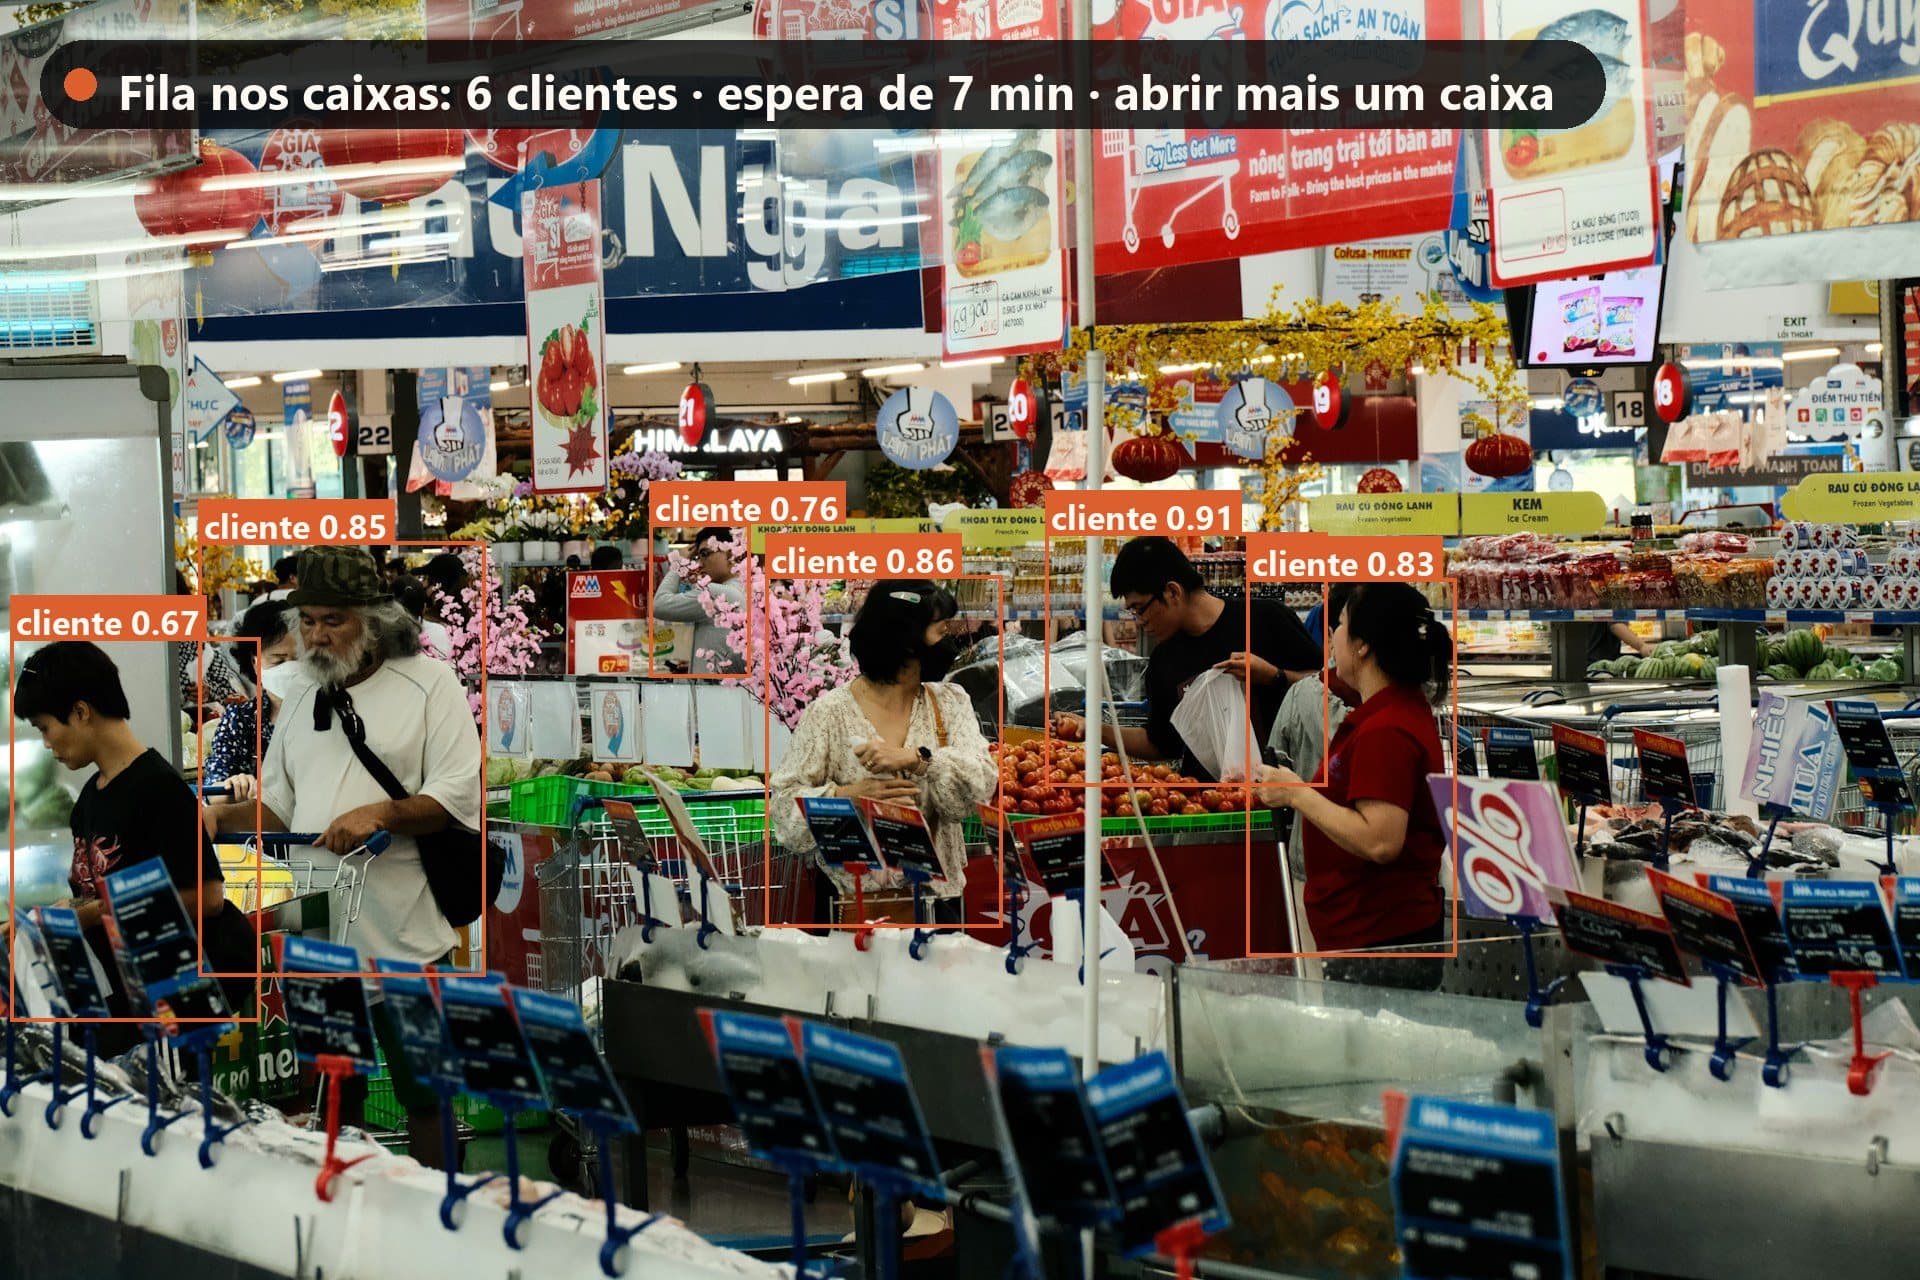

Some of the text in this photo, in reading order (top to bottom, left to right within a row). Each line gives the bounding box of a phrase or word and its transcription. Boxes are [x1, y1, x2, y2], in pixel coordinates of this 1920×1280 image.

[1166, 142, 1188, 164] Less
[1190, 138, 1208, 158] Get
[1249, 149, 1285, 179] nông
[1291, 144, 1334, 172] trang
[1336, 131, 1365, 168] trại
[1368, 129, 1392, 159] tới
[1250, 188, 1270, 204] Farm
[1271, 187, 1280, 200] to
[1306, 179, 1329, 196] Bring
[1330, 175, 1345, 191] the
[1346, 173, 1365, 189] best
[1366, 170, 1391, 189] prices
[1392, 167, 1401, 181] in
[1403, 164, 1419, 181] the
[1420, 159, 1454, 178] market
[1783, 316, 1807, 327] EXIT
[1656, 378, 1673, 405] 18
[1839, 392, 1858, 403] THU
[1616, 401, 1643, 418] 18
[994, 413, 1009, 432] 2
[359, 426, 390, 446] 22
[634, 429, 783, 453] HIMLAYA
[1828, 483, 1849, 494] RAU
[1853, 481, 1867, 493] CỦ
[1871, 480, 1904, 493] ĐÔNG
[1336, 502, 1355, 511] RAU
[1406, 501, 1433, 512] LẠNH
[1513, 498, 1542, 510] KEM
[1878, 499, 1913, 508] Vegetables
[961, 516, 989, 525] KHOAI
[991, 513, 1008, 524] TÂY
[1011, 513, 1037, 524] ĐÔNG
[1507, 514, 1549, 523] Ice Cream
